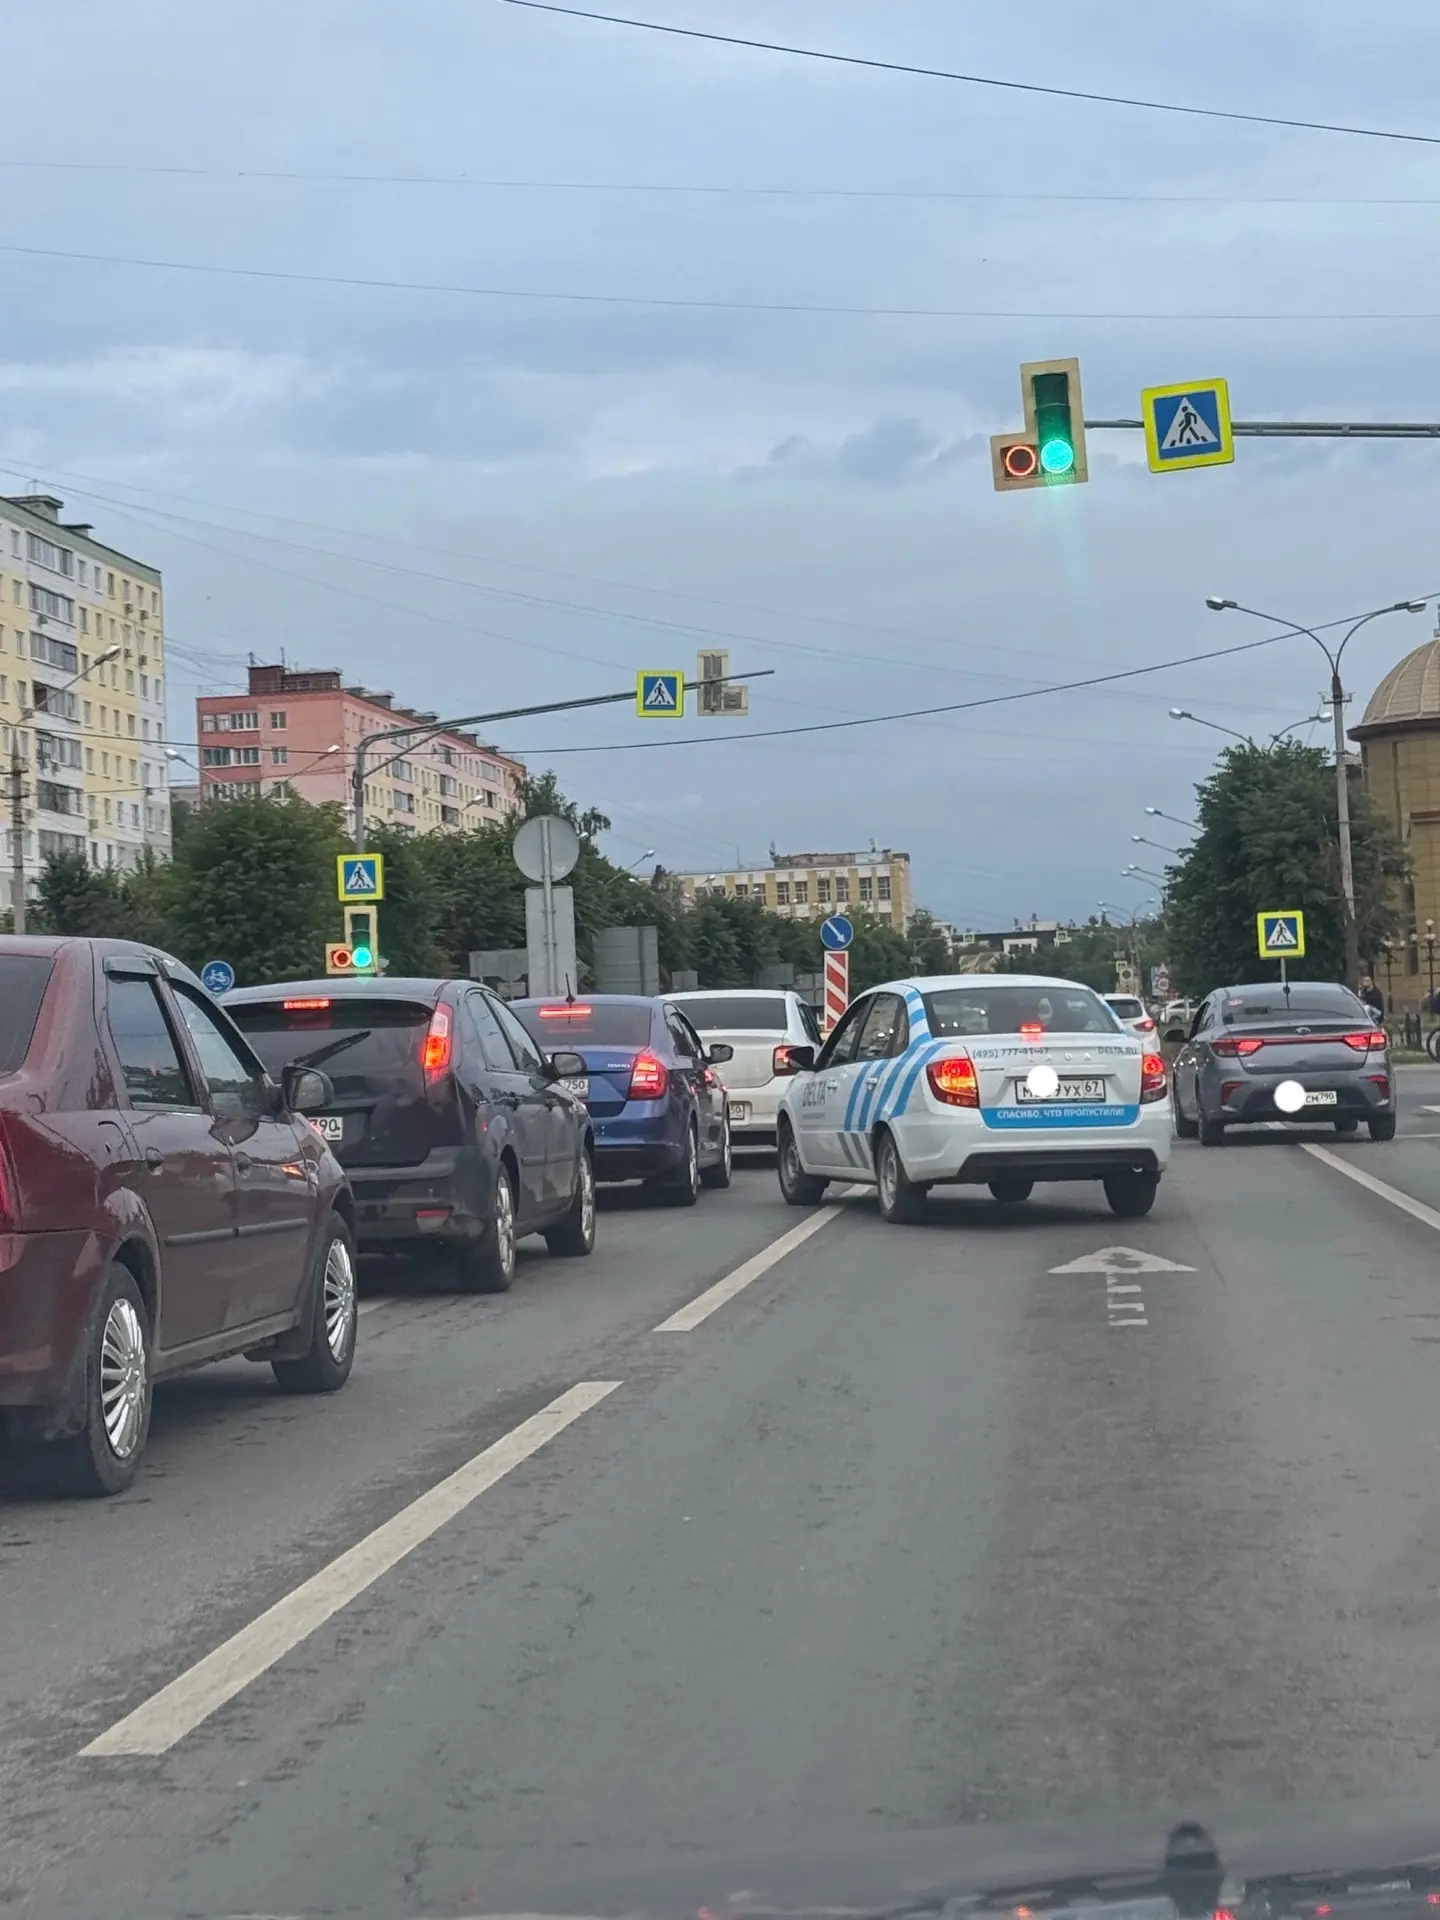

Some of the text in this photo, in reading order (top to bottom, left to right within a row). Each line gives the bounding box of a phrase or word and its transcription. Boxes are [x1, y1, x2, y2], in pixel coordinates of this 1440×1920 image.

[1085, 1080, 1098, 1092] 67
[1043, 1108, 1062, 1117] ЧТО
[1063, 1107, 1125, 1117] ПРОПУСТИЛИ!
